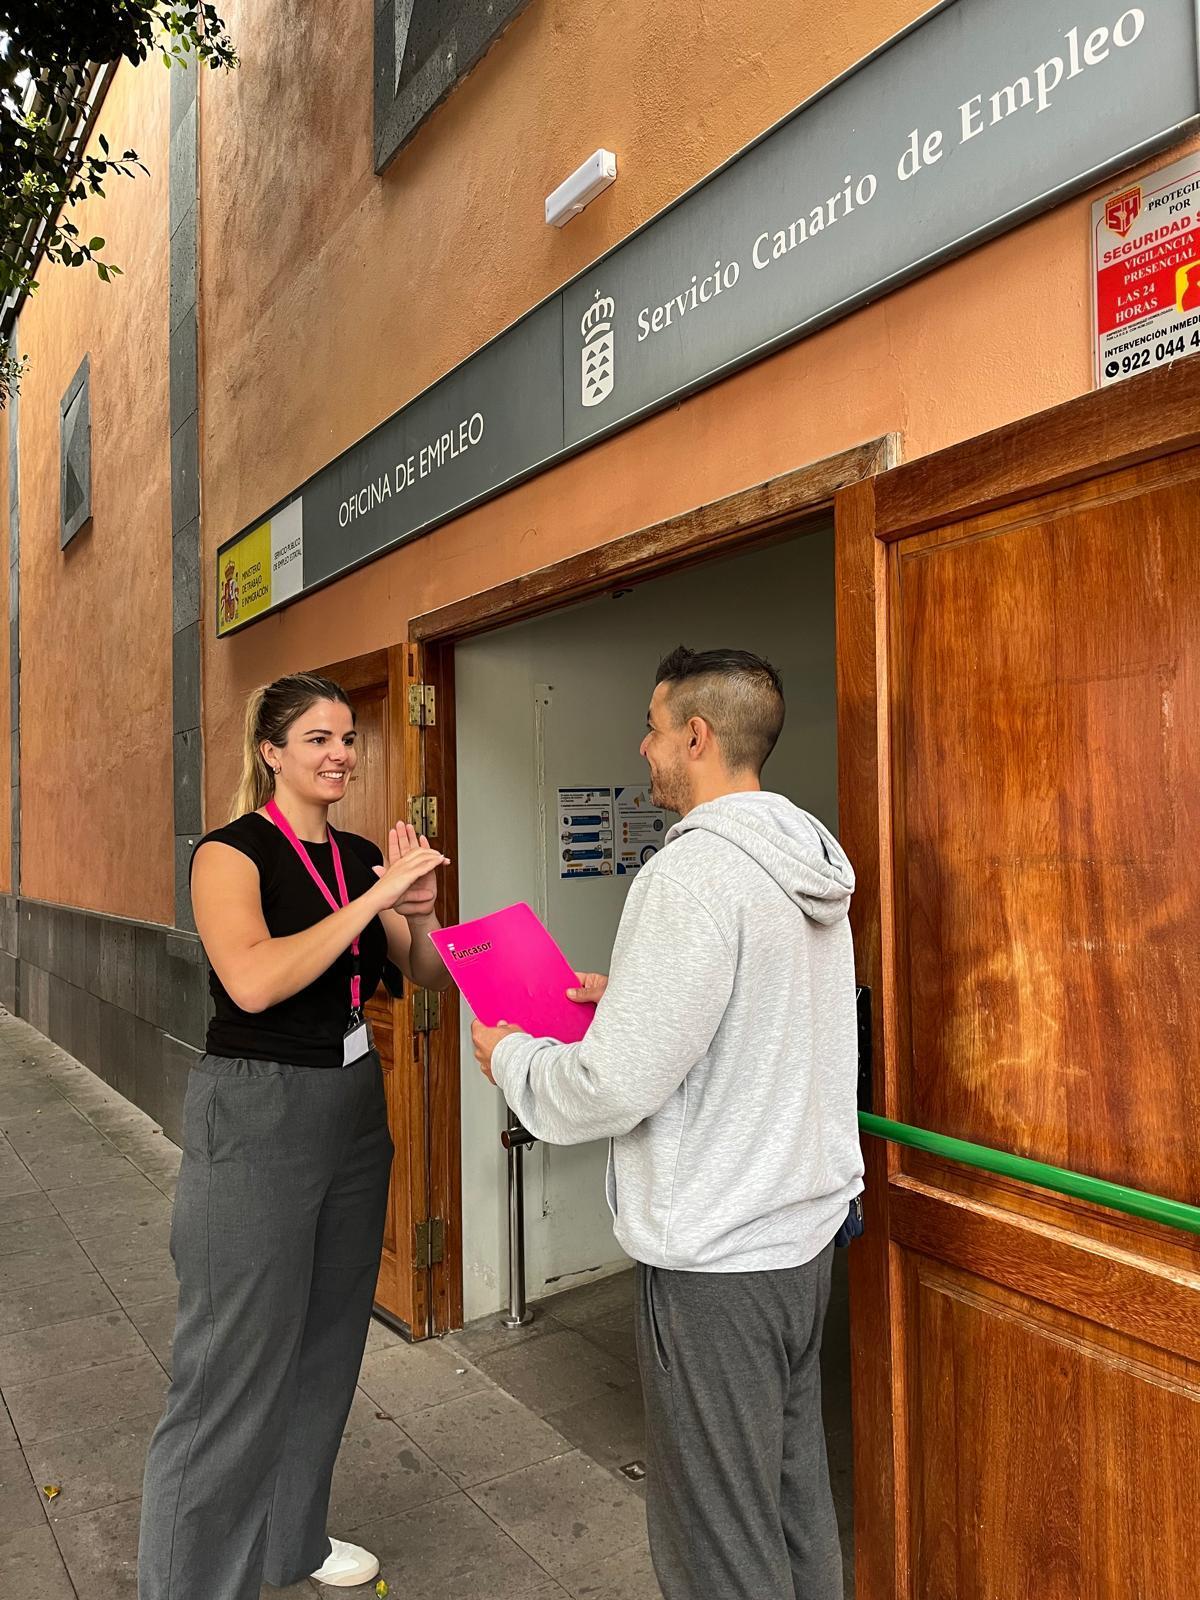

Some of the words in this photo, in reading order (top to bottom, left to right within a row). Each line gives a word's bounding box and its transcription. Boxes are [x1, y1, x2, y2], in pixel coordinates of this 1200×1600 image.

[637, 260, 740, 342] Servicio
[752, 174, 877, 270] Canario
[897, 128, 943, 181] de
[957, 8, 1145, 145] Empleo
[1169, 198, 1191, 215] POR
[1103, 216, 1191, 263] SEGURIDAD
[1125, 233, 1194, 270] VIGILANCIA
[1124, 248, 1196, 285] PRESENCIAL
[1115, 297, 1158, 324] HORAS
[1117, 289, 1140, 307] LAS
[1143, 282, 1155, 296] 24
[1104, 328, 1167, 358] INTERVENCIÓN
[1122, 348, 1150, 374] 922
[1155, 335, 1185, 361] 044
[338, 473, 391, 527] OFICINA
[395, 455, 415, 493] DE
[419, 412, 484, 479] EMPLEO
[451, 942, 491, 960] Funcasor
